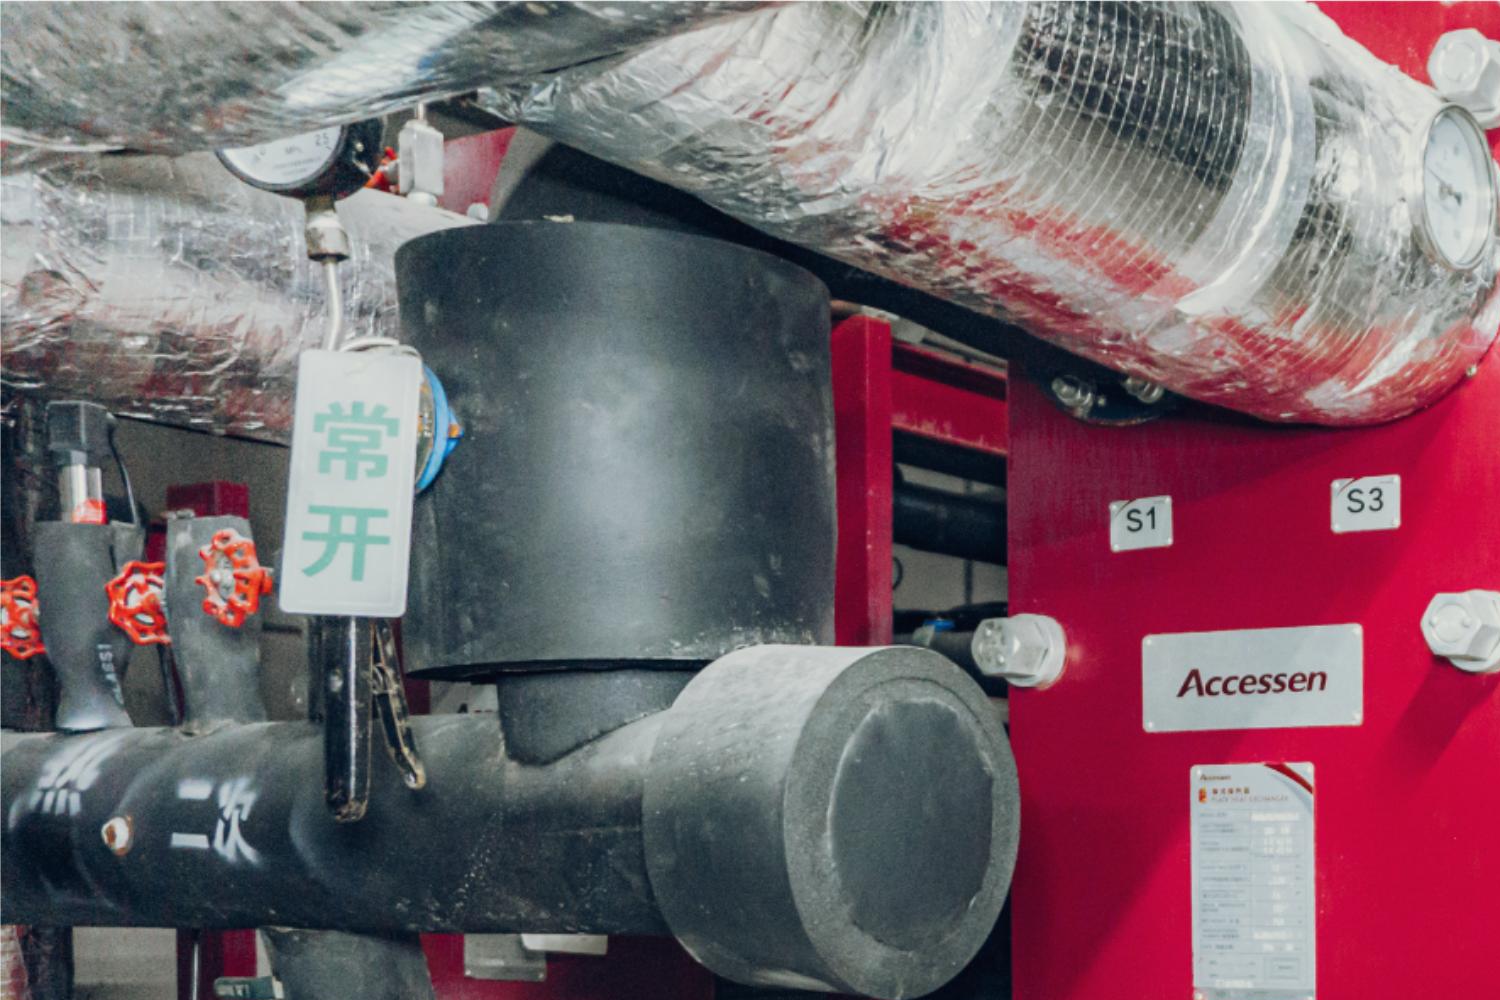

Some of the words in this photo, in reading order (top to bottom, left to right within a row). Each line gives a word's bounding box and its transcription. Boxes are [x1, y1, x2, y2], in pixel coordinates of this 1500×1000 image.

[302, 401, 400, 582] 常开
[1346, 487, 1385, 514] S3
[1125, 505, 1157, 533] S1
[1176, 667, 1328, 699] Accessen
